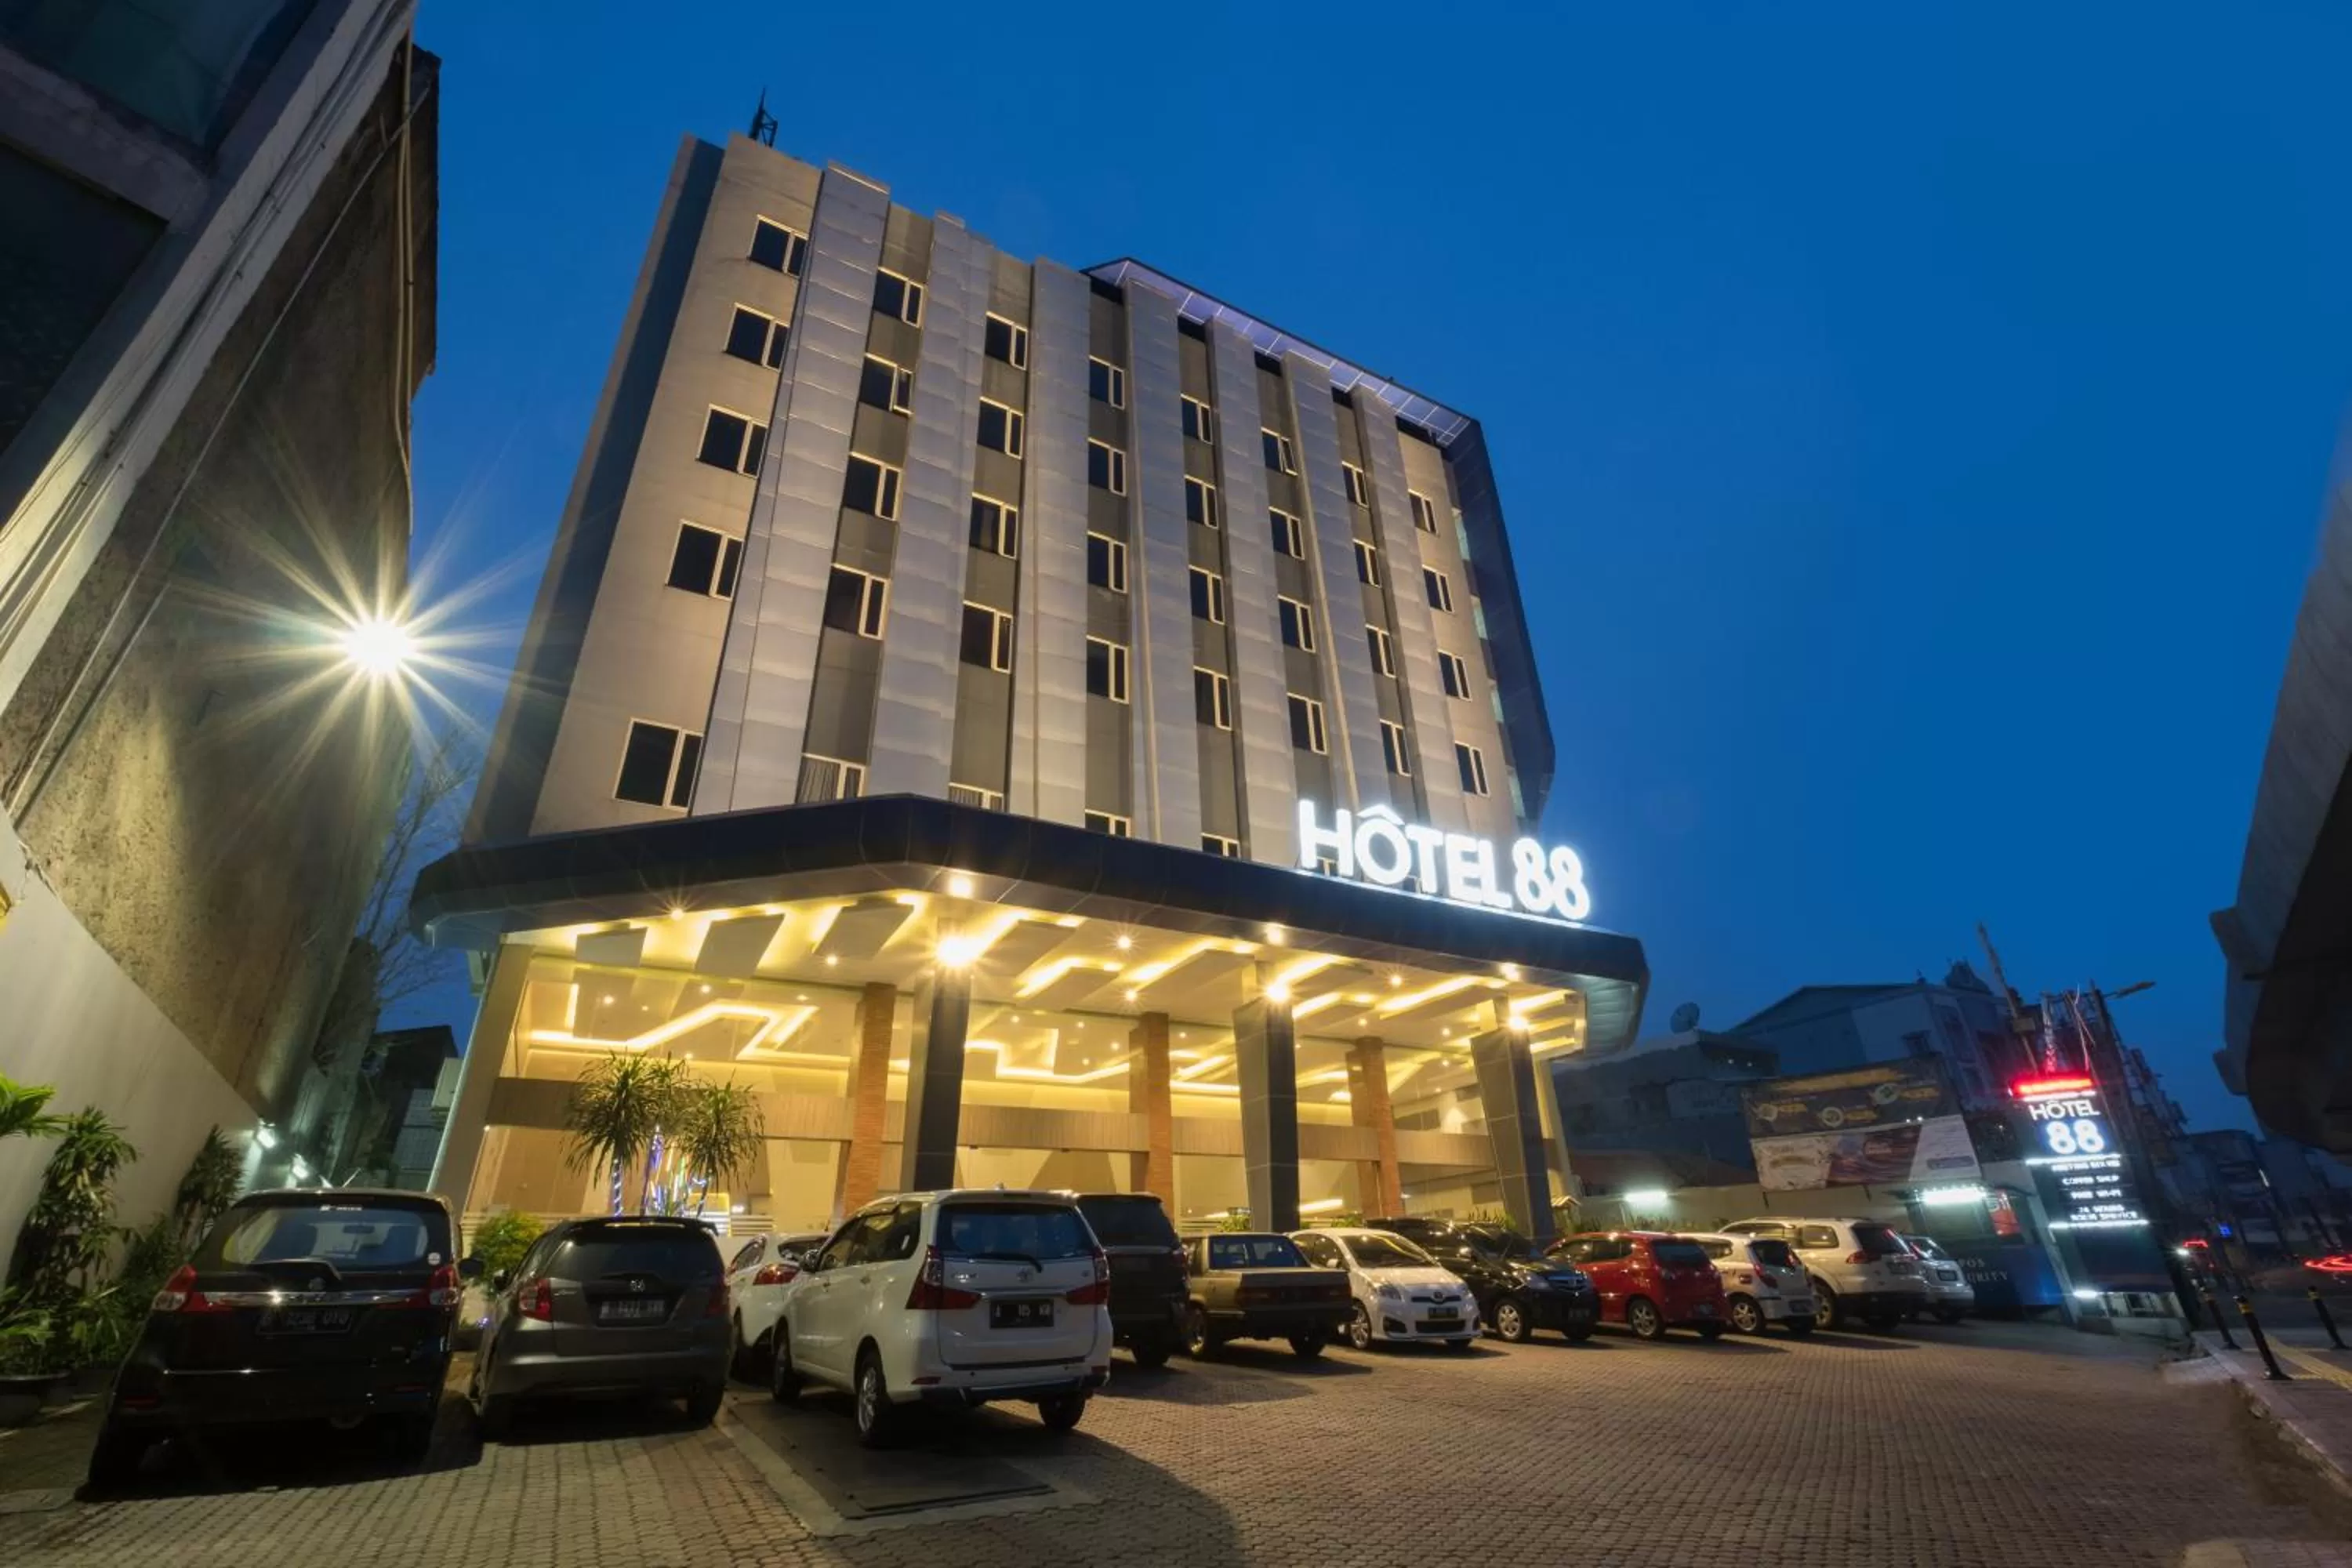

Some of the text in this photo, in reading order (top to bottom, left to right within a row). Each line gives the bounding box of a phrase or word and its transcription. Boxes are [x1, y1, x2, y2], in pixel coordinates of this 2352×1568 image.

[1299, 798, 1591, 920] HÔTEL 88
[2045, 1119, 2106, 1155] 88
